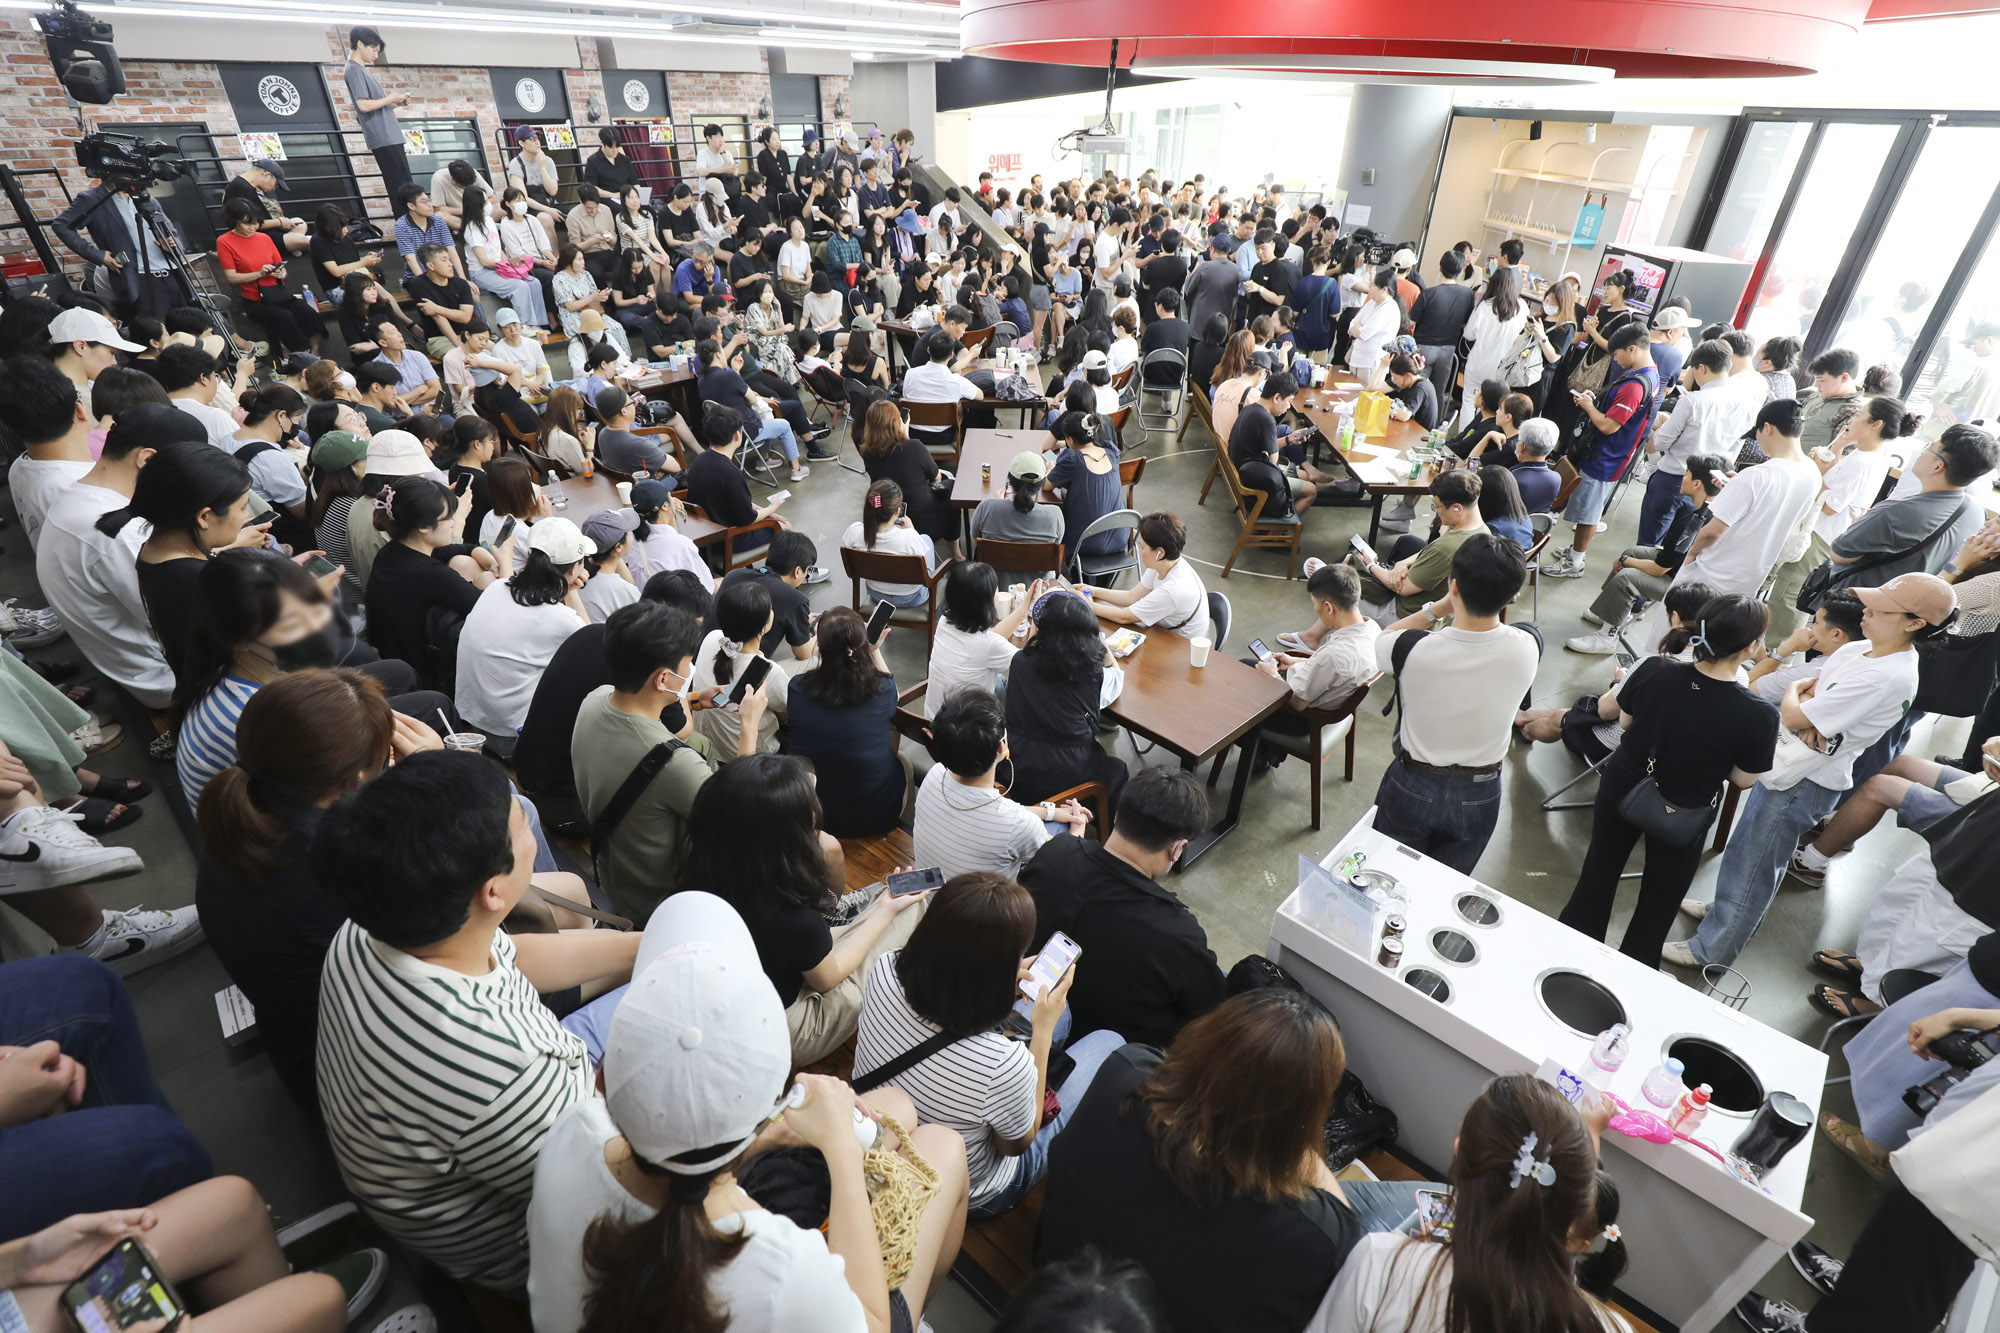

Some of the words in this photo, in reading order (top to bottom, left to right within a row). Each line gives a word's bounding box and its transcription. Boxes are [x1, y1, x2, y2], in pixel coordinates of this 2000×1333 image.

[274, 77, 299, 99] JOHNS
[267, 102, 298, 114] COFFEE
[988, 153, 1023, 173] 위메프
